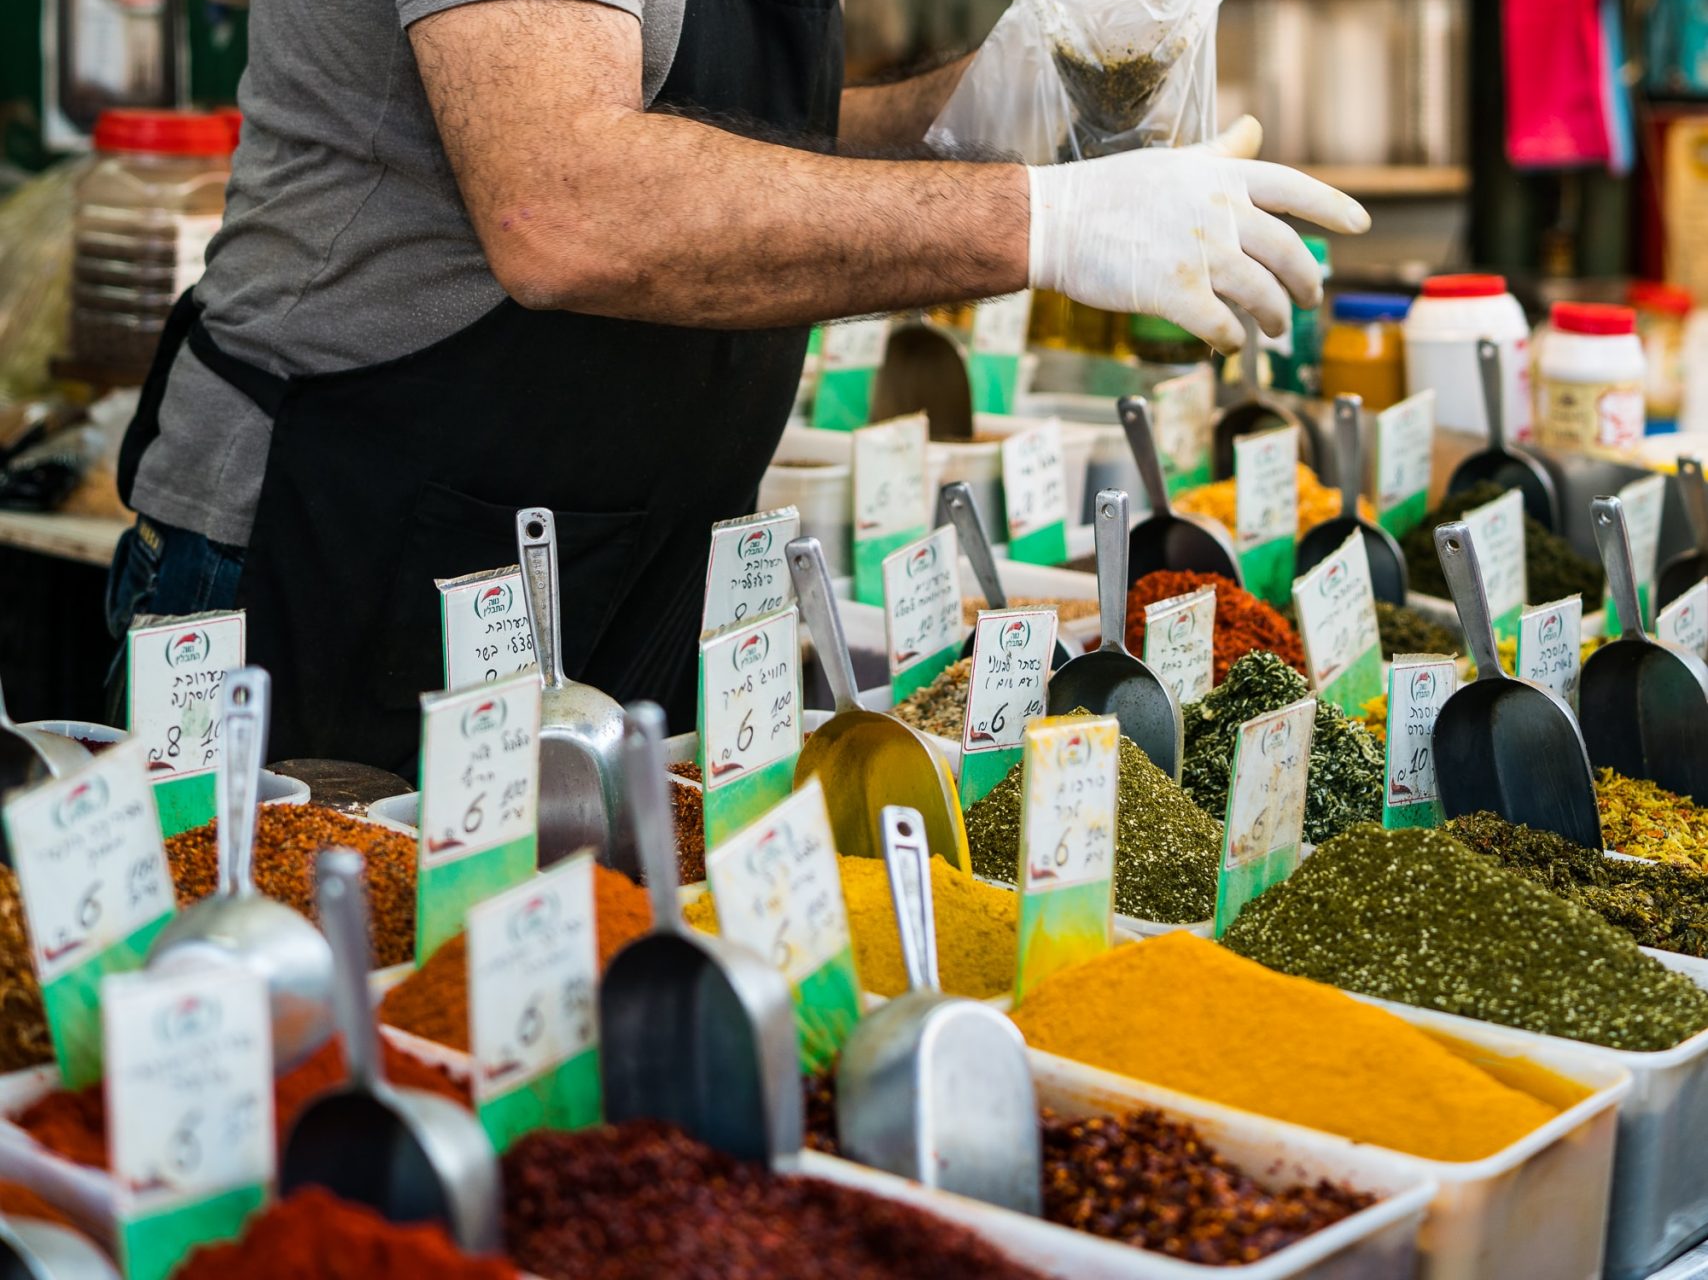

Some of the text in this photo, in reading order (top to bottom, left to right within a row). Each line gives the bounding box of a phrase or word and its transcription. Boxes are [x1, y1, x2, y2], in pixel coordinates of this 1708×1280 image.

[483, 604, 505, 617] התבלין
[770, 691, 793, 718] 100
[991, 701, 1009, 733] 6
[167, 724, 182, 758] 8
[736, 708, 754, 753] 6
[1409, 747, 1429, 775] 10
[462, 792, 488, 834] 6
[1055, 826, 1072, 868] 6
